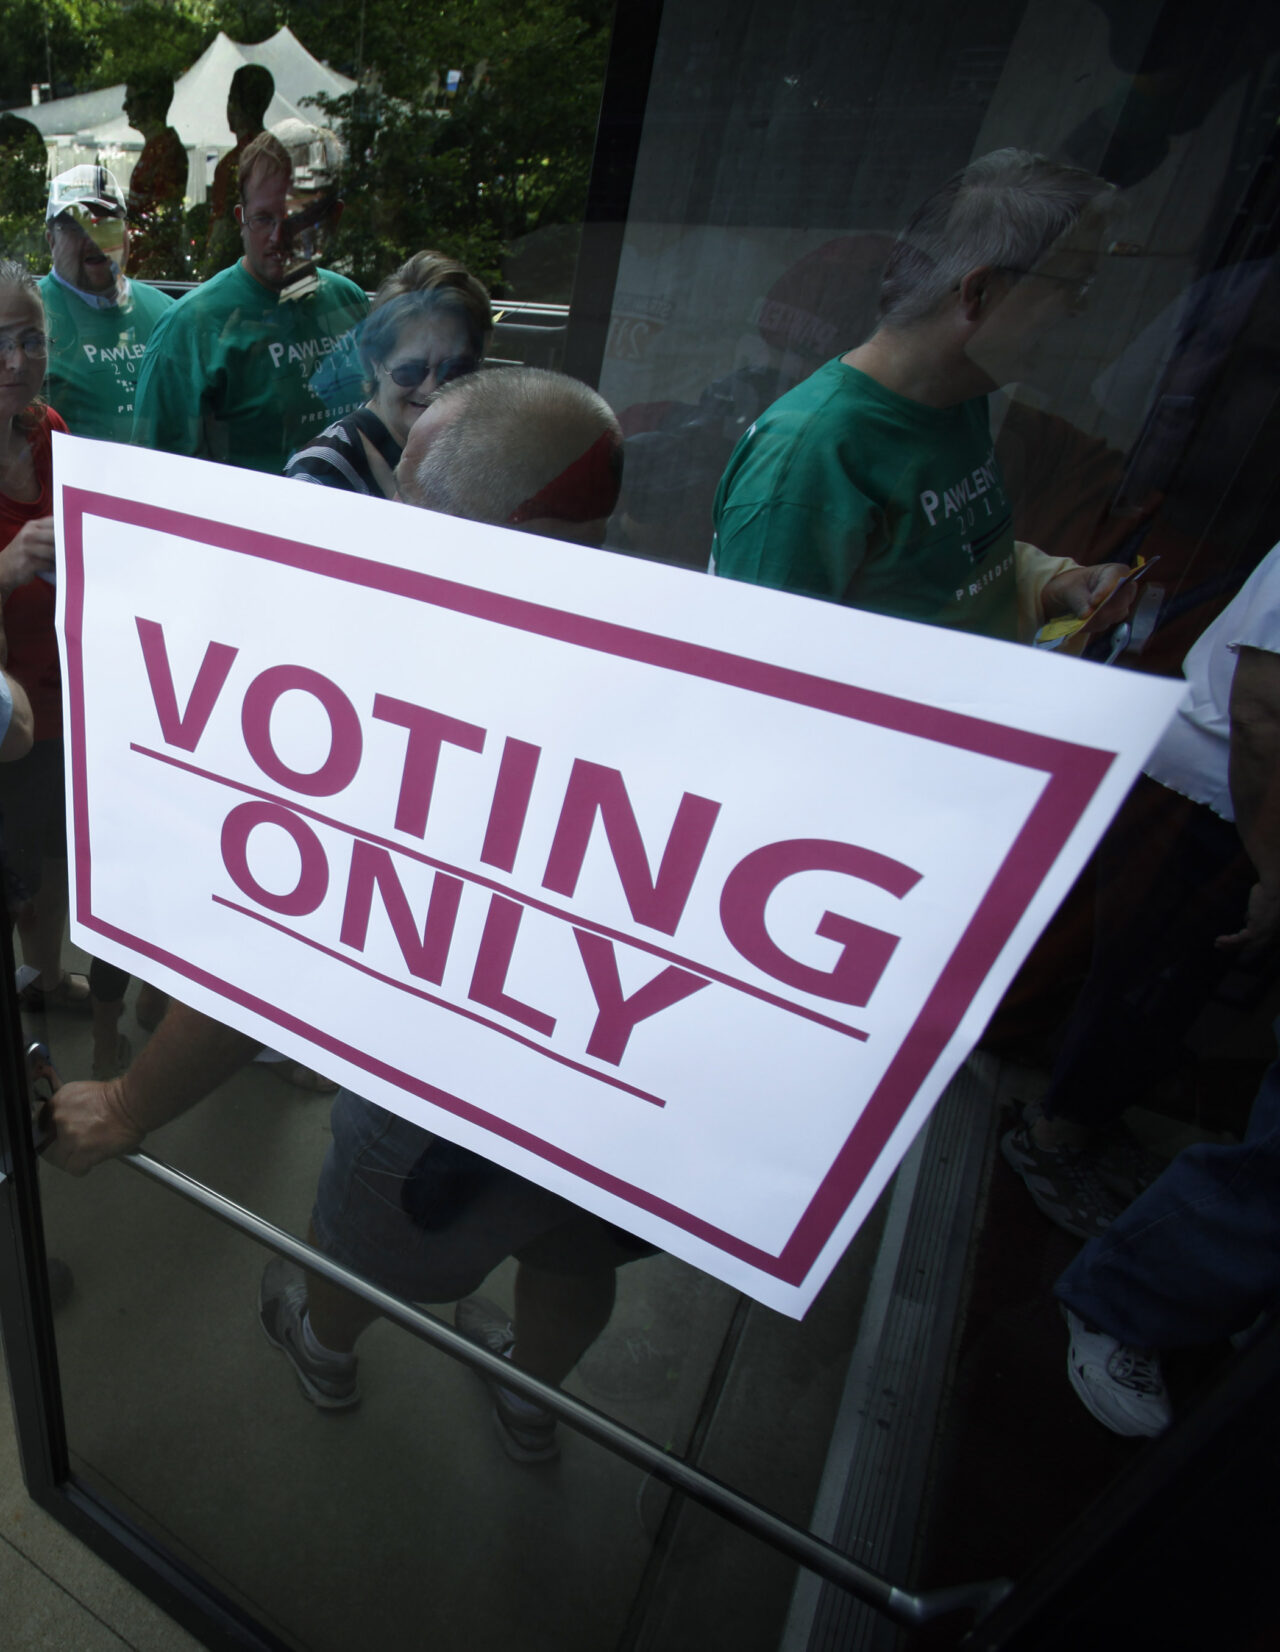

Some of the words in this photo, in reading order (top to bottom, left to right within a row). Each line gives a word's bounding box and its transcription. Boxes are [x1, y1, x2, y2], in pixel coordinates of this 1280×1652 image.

[268, 329, 358, 368] PAWLENTY
[300, 353, 352, 378] 2012
[135, 617, 924, 1008] VOTING
[220, 800, 713, 1066] ONLY
